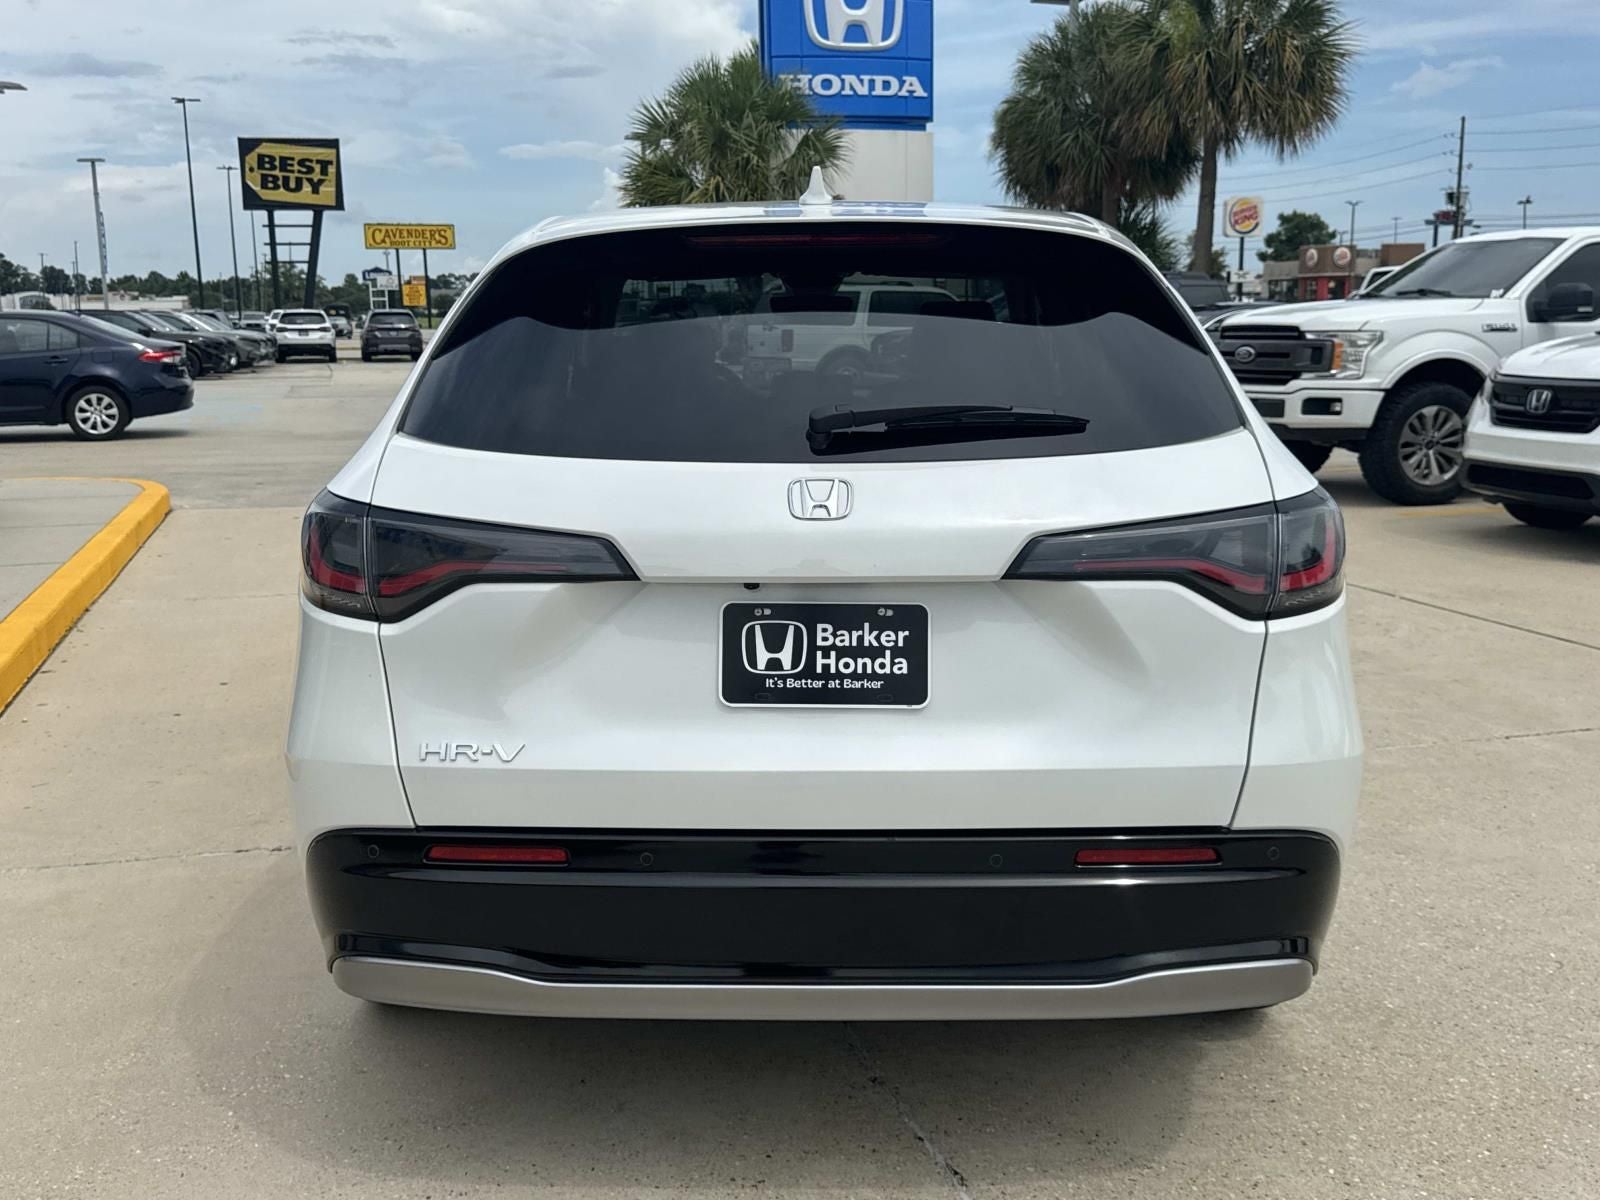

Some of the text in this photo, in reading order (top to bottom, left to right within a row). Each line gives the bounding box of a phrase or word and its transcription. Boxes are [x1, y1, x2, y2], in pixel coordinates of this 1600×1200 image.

[778, 74, 928, 98] HONDA
[257, 153, 334, 177] BEST
[260, 173, 328, 195] BUY
[371, 227, 449, 246] CAVENDER'S
[815, 622, 910, 647] Barker
[815, 650, 908, 675] Honda
[765, 677, 885, 689] It's Better at Barker
[418, 742, 526, 763] HR-V
